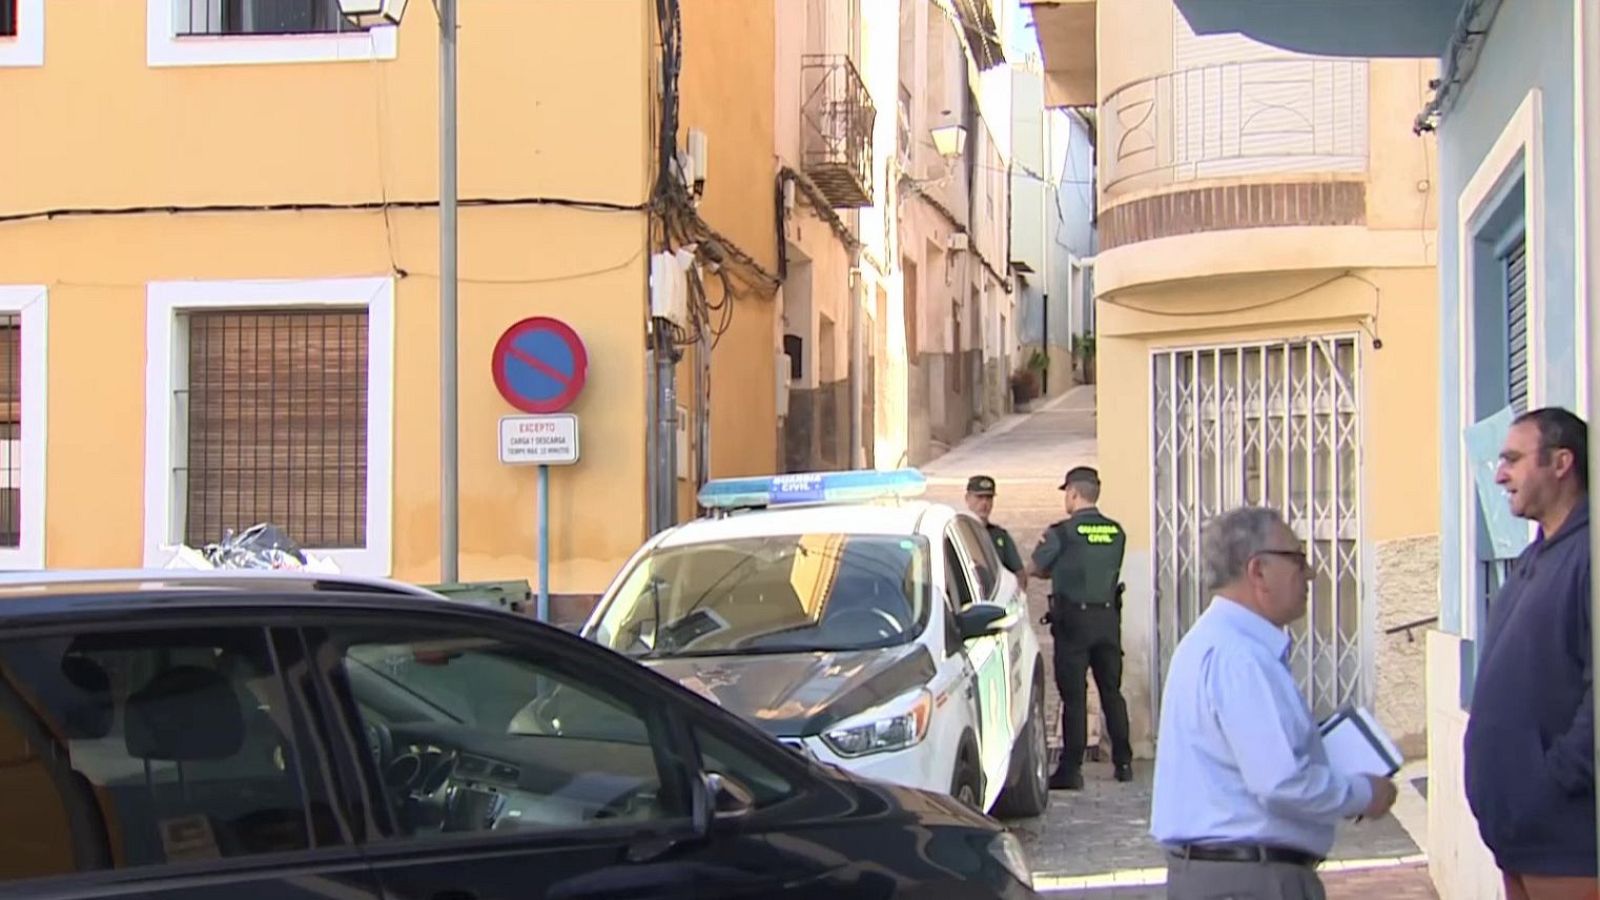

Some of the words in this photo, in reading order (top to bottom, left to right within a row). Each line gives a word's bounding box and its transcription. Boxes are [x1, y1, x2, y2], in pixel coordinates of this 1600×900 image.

[519, 423, 555, 432] EXCEPTO
[510, 437, 530, 445] CARGA
[536, 436, 565, 444] DESCARGA
[773, 475, 821, 485] GUARDIA
[782, 482, 810, 491] CIVIL
[1077, 525, 1118, 534] GUARDIA
[1087, 534, 1113, 543] CIVIL
